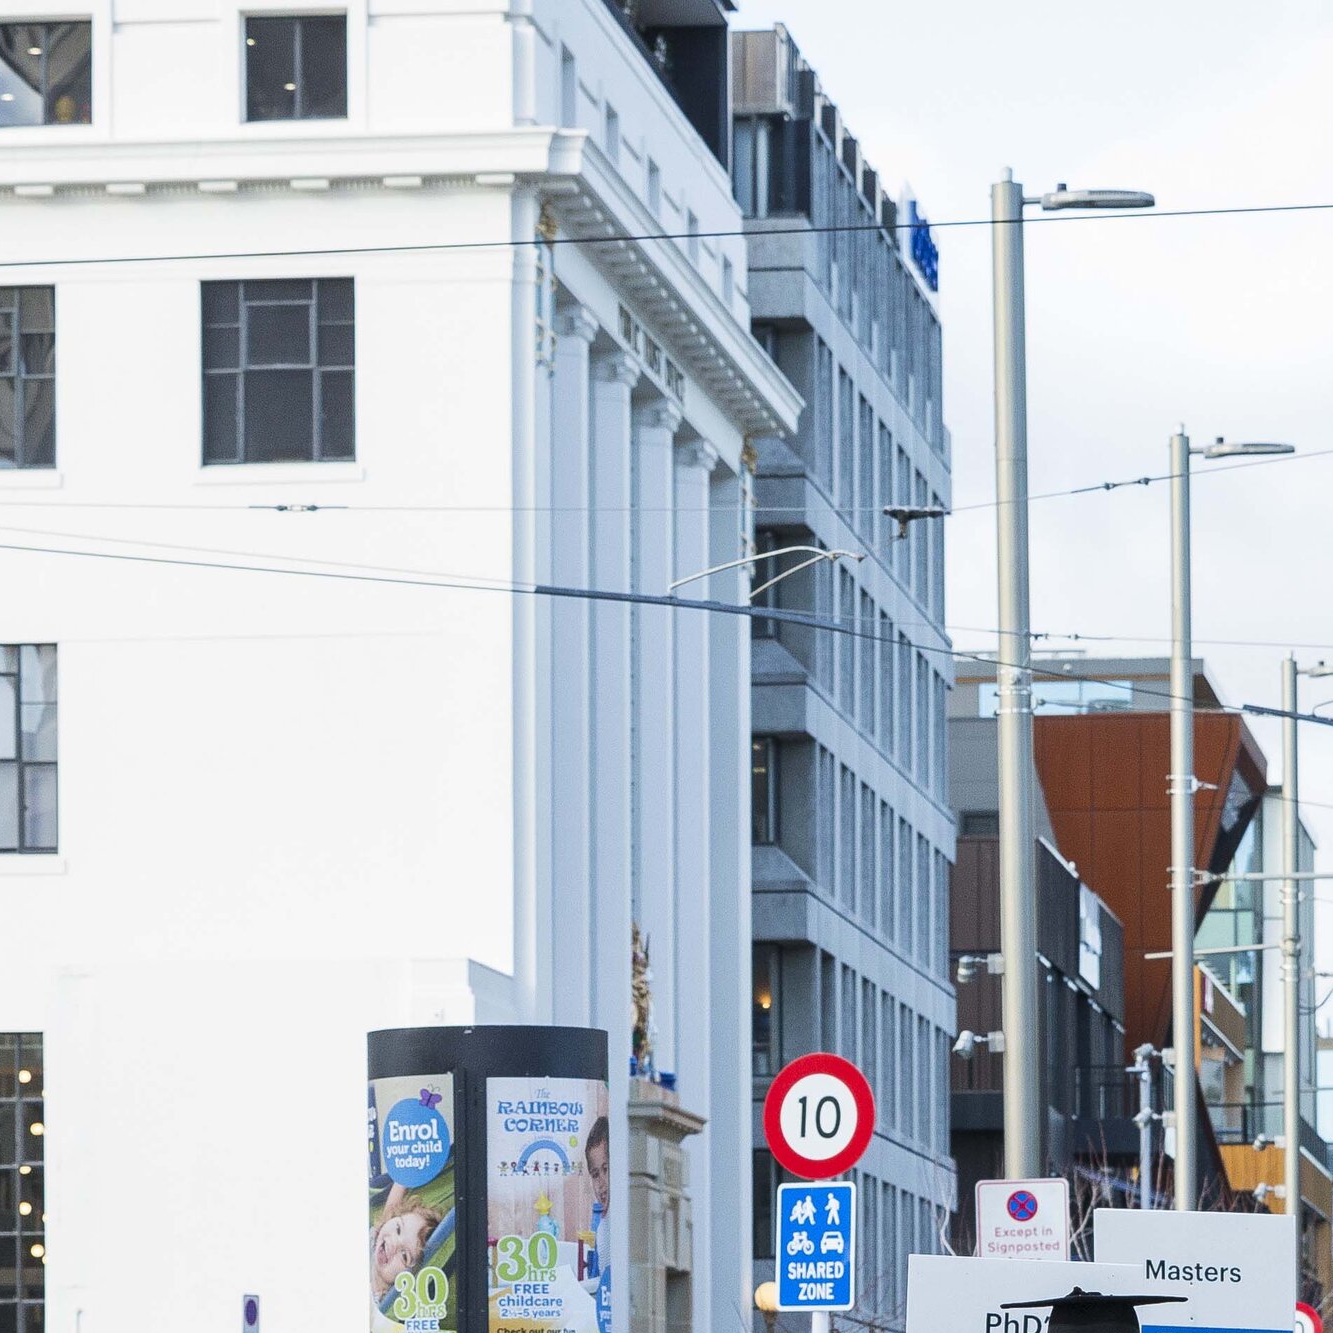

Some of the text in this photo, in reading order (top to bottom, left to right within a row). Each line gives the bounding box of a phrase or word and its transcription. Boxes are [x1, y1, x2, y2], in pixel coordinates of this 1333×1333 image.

[535, 1088, 551, 1099] The
[496, 1100, 584, 1116] RAINBOW
[504, 1118, 579, 1132] CORNER
[798, 1095, 842, 1139] 10
[388, 1118, 439, 1142] Enrol
[386, 1140, 443, 1158] your child
[395, 1155, 430, 1170] today!
[994, 1226, 1053, 1238] Except in
[987, 1241, 1060, 1255] Signposted
[497, 1232, 558, 1281] 30
[528, 1264, 557, 1282] hrs
[787, 1261, 845, 1280] SHARED
[1145, 1259, 1242, 1283] Masters
[394, 1267, 448, 1319] 30
[514, 1284, 549, 1294] FREE
[798, 1283, 835, 1301] ZONE
[498, 1295, 563, 1307] childcare
[417, 1302, 447, 1318] hrs
[532, 1308, 561, 1318] years
[406, 1320, 438, 1331] FREE
